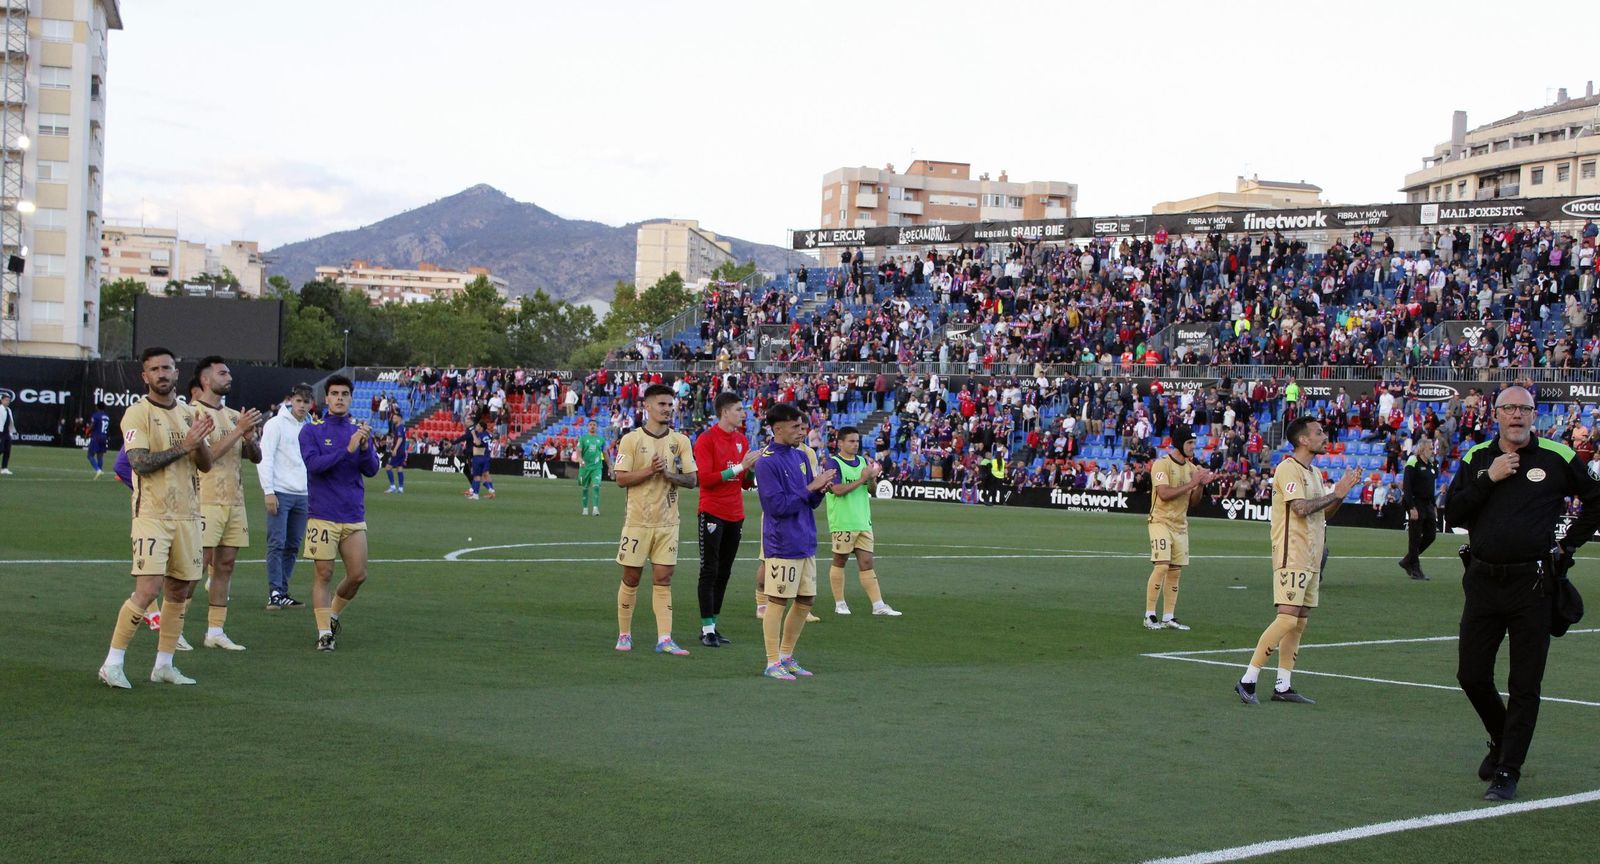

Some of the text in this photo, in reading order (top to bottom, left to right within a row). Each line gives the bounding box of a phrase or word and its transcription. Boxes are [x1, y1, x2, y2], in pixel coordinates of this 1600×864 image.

[1337, 209, 1389, 220] FIBRA Y MÓVIL
[1440, 208, 1468, 219] MAIL
[1469, 207, 1501, 218] BOXES
[1187, 217, 1207, 225] FIBRA
[1213, 215, 1234, 224] MÓVIL
[1243, 211, 1328, 230] finetwork
[1011, 225, 1042, 237] GRADE
[1045, 224, 1065, 235] ONE
[19, 388, 71, 405] car
[1569, 385, 1600, 397] PALL
[433, 456, 449, 465] Next
[523, 460, 541, 471] ELDA
[1050, 489, 1129, 509] finetwork
[311, 527, 329, 544] 24
[836, 531, 851, 543] 23
[138, 538, 157, 556] 17
[621, 536, 639, 554] 27
[1154, 538, 1167, 551] 19
[780, 566, 796, 583] 10
[1290, 572, 1307, 589] 12
